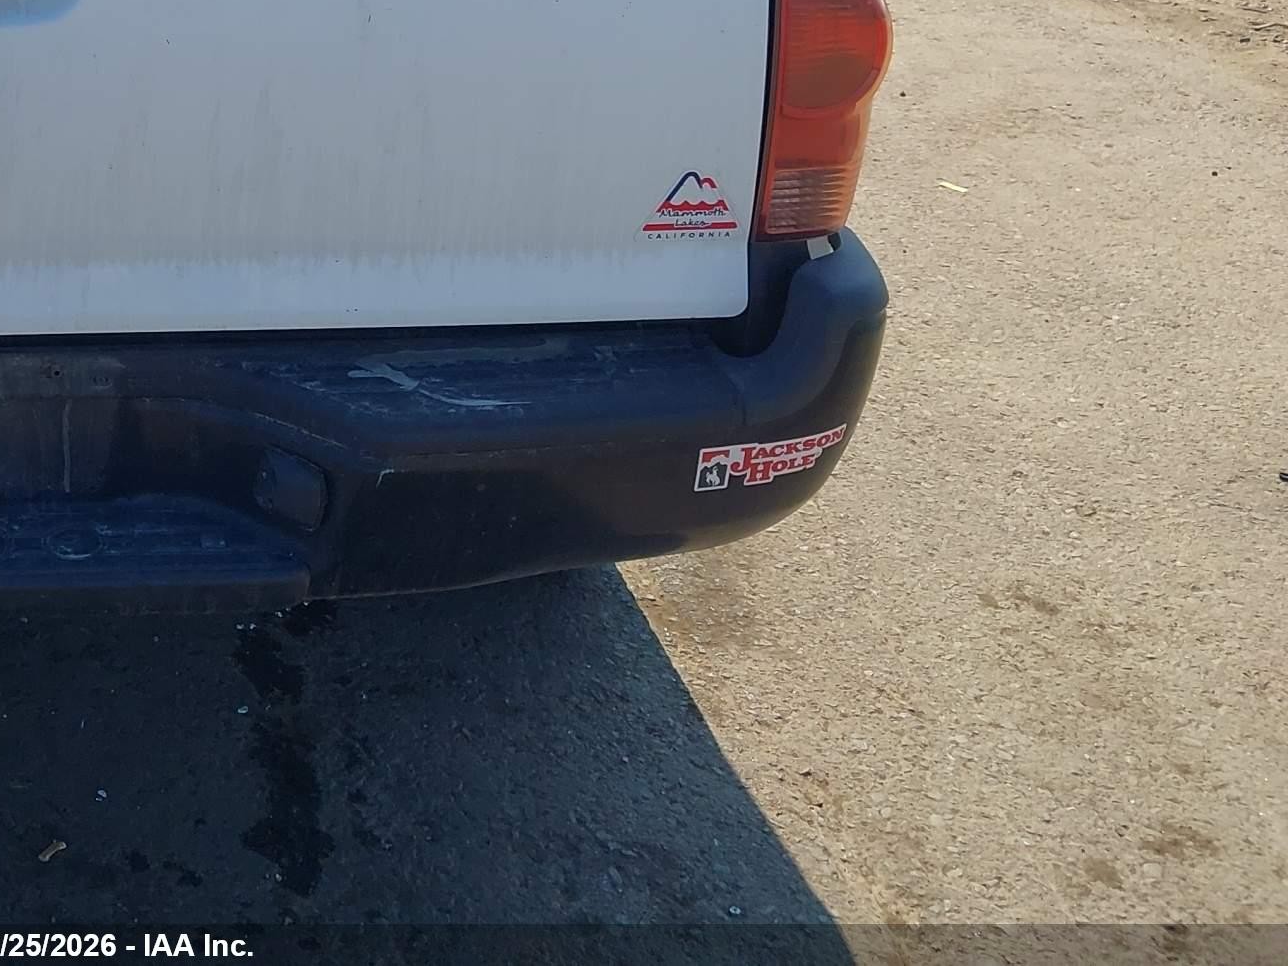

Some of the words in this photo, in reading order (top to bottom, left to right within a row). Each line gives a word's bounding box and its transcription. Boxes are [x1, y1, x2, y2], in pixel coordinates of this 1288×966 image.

[659, 207, 726, 218] Mammoth
[675, 218, 710, 227] Lakes
[647, 231, 731, 240] CALIFORNIA
[730, 428, 845, 473] JACKSON
[746, 454, 817, 483] HOLE
